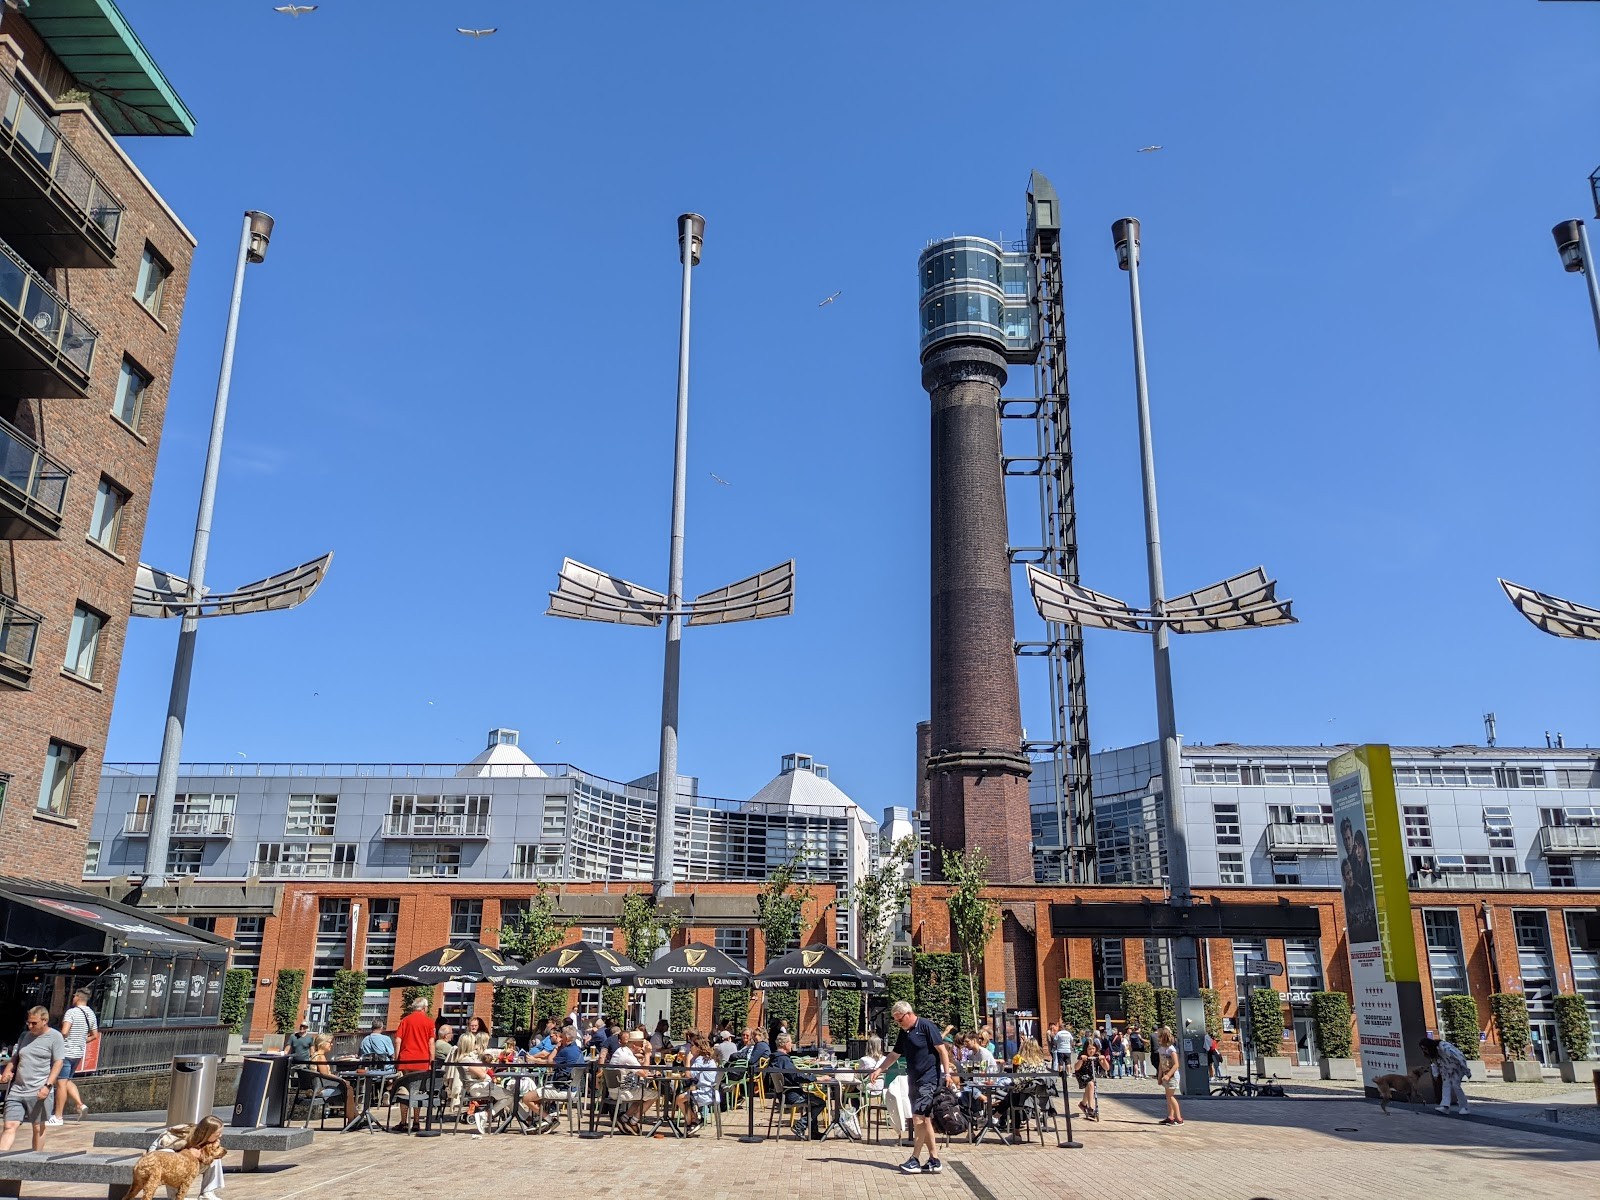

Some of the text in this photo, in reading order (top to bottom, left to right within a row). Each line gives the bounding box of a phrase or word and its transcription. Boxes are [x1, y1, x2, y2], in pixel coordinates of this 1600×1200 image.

[418, 965, 462, 973] GUINNESS
[784, 967, 831, 975] GUINNESS
[512, 978, 540, 986] GUINNESS
[576, 979, 601, 987] GUINNESS
[714, 978, 742, 986] GUINNESS
[761, 980, 790, 988] GUINNESS
[829, 980, 857, 988] GUINNESS
[1279, 990, 1314, 1001] erato
[1018, 1020, 1033, 1036] KY
[1360, 1037, 1402, 1048] BIKERIDERS
